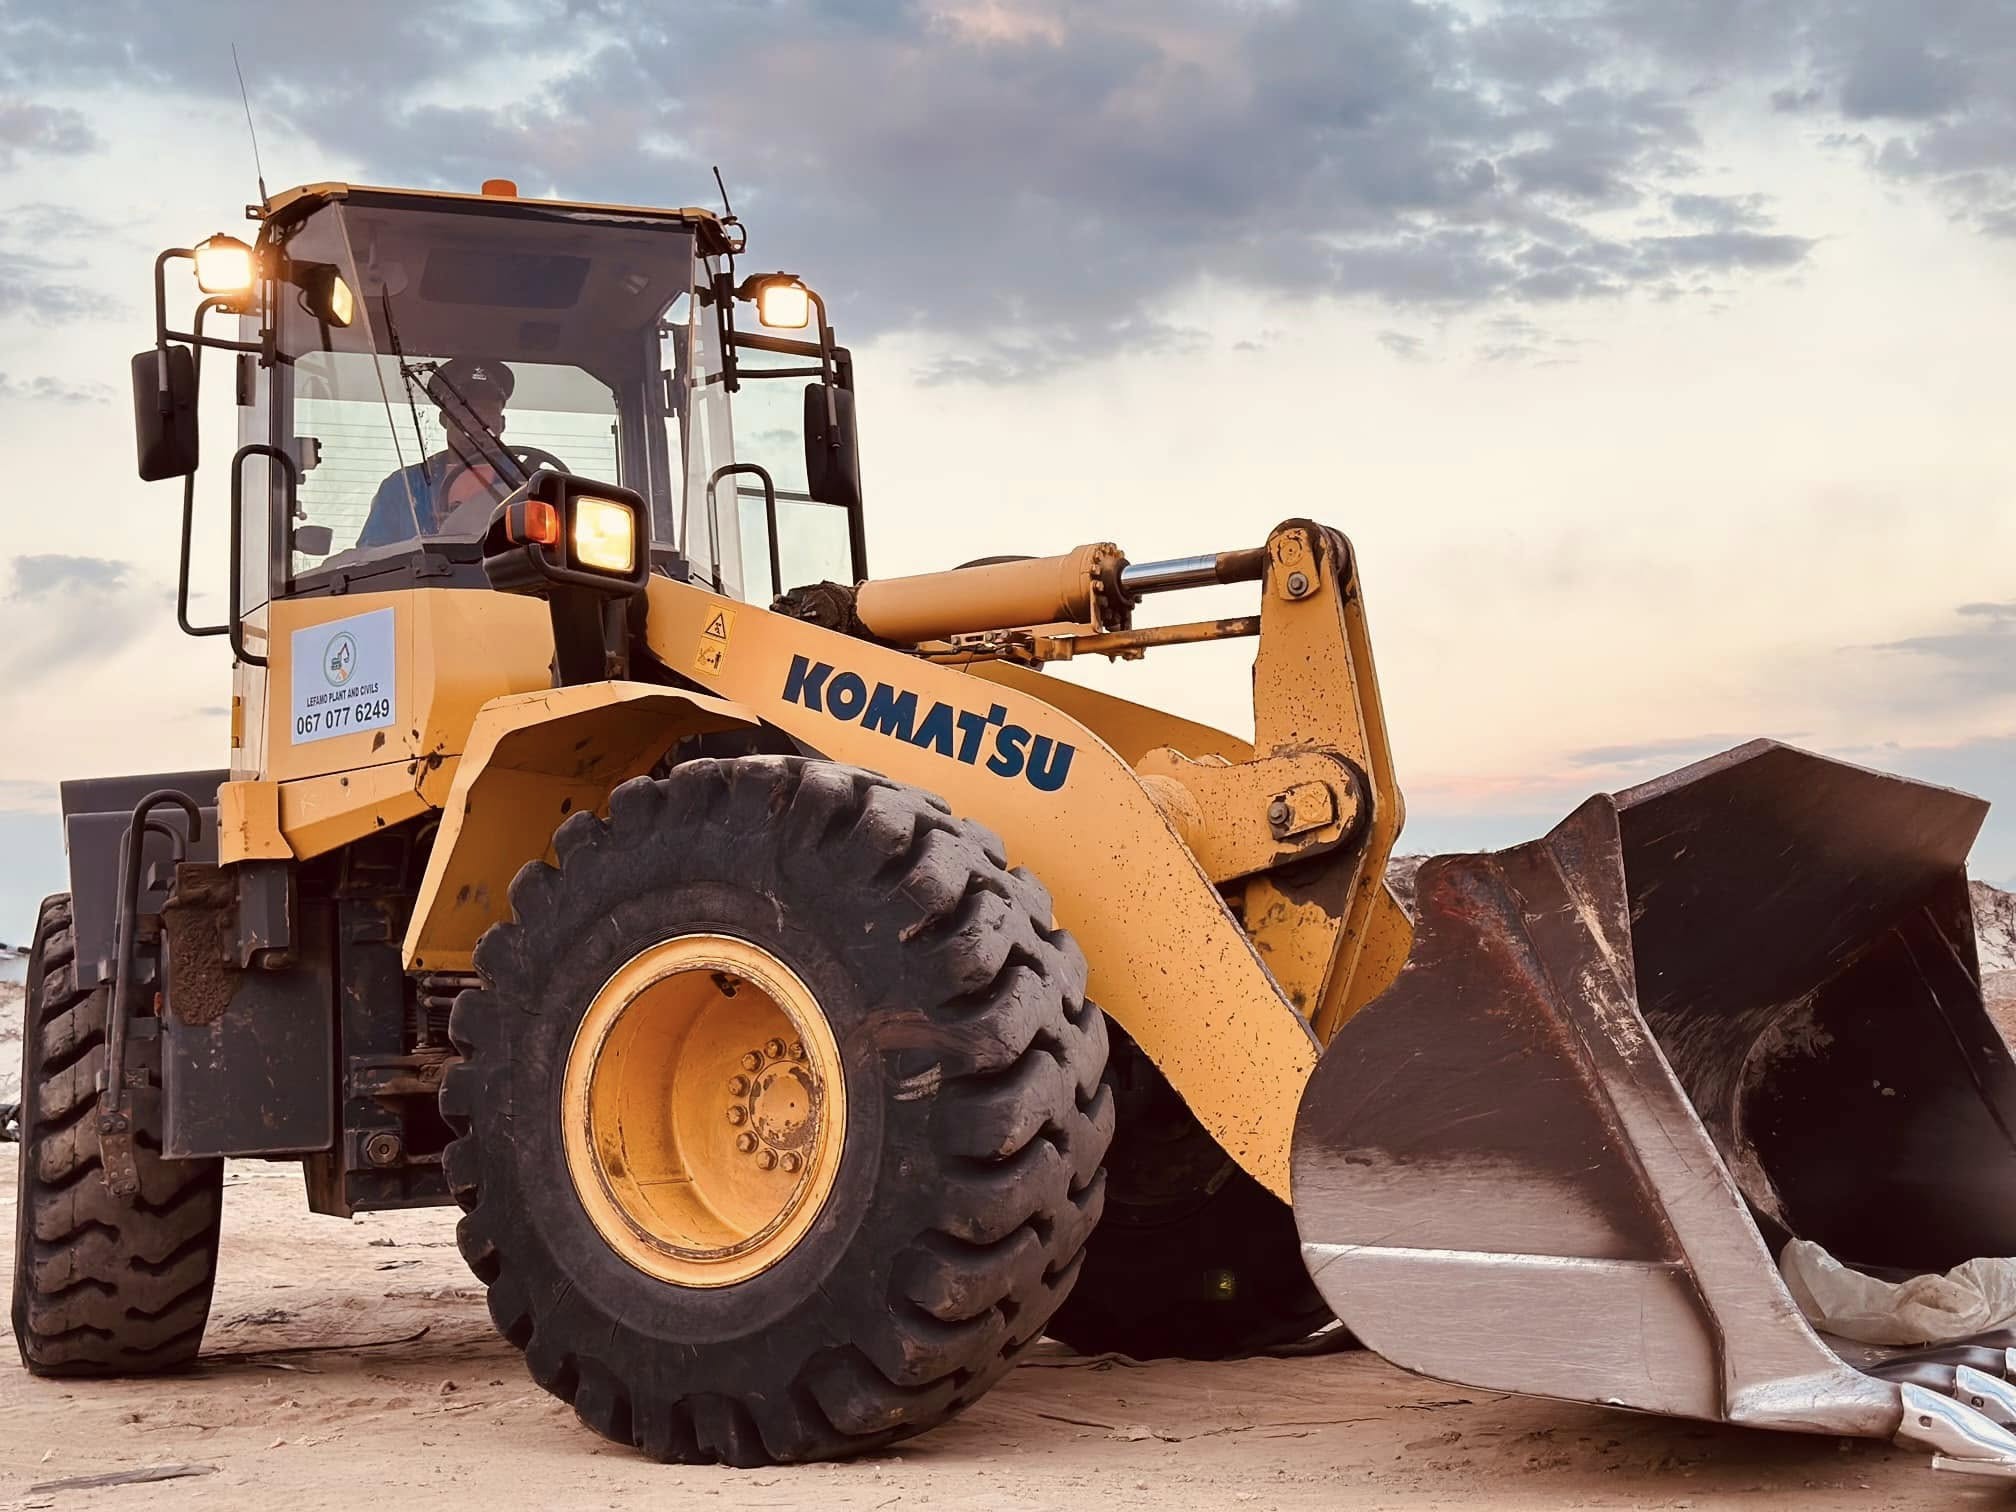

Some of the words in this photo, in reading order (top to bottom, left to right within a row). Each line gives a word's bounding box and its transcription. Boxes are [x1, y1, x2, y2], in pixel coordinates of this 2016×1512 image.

[306, 694, 328, 708] LEFAMO
[328, 690, 347, 703] PLANT
[347, 687, 359, 698] AND
[359, 682, 379, 696] CIVILS
[296, 713, 321, 735] 067
[325, 706, 351, 729] 077
[355, 698, 390, 723] 6249
[782, 654, 1076, 792] KOMATSU
